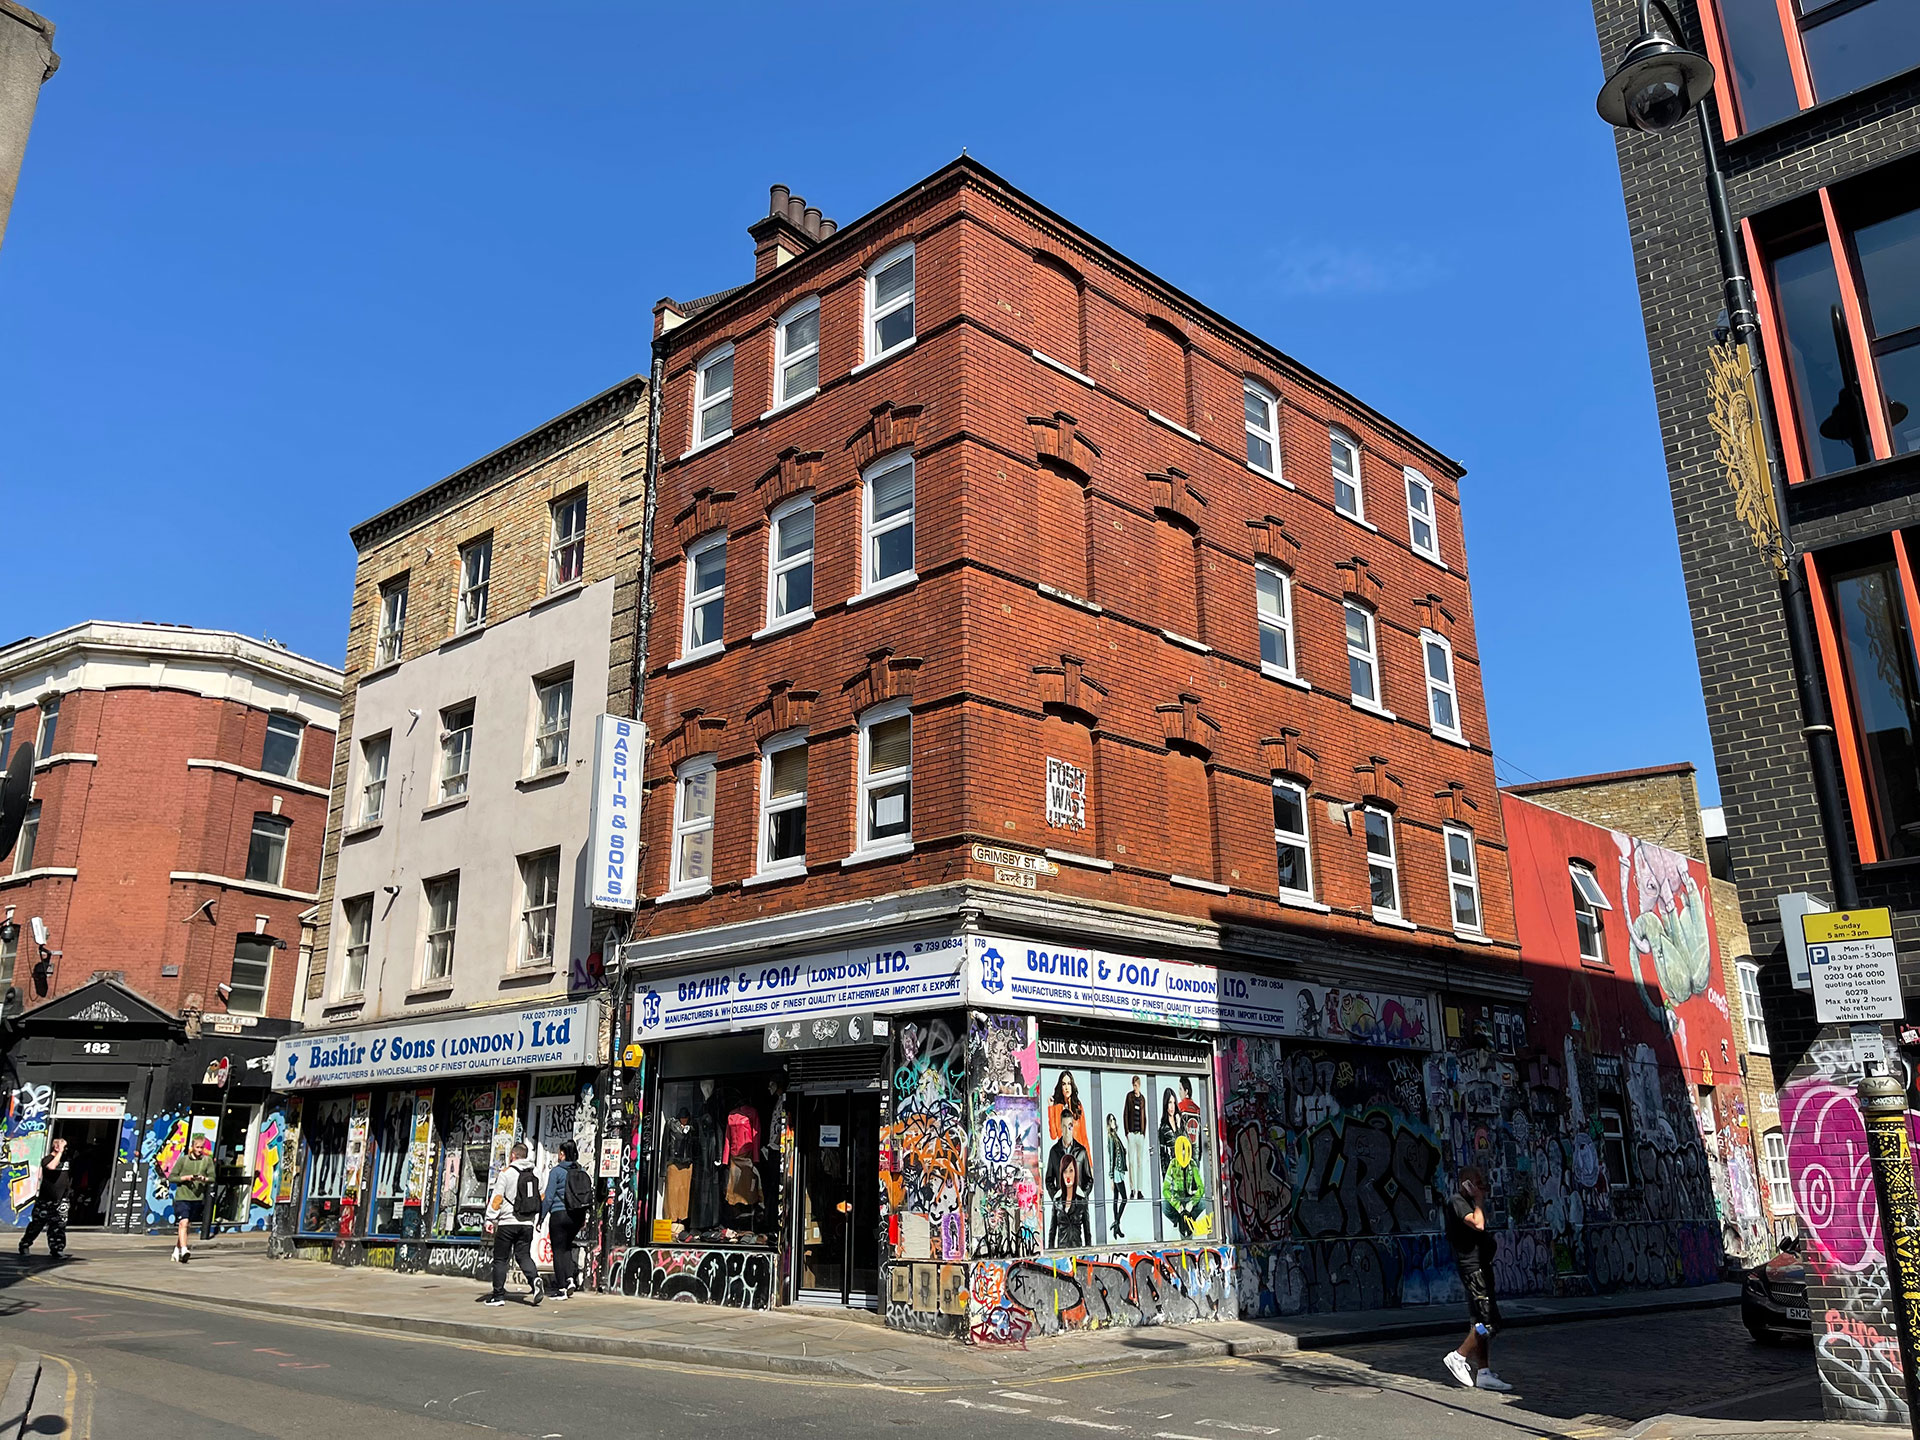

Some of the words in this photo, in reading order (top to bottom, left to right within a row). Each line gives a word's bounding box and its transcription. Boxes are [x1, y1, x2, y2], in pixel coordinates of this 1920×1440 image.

[613, 722, 630, 808] BASHIR
[612, 815, 627, 829] &
[608, 834, 625, 895] SONS
[977, 848, 1020, 866] GRIMSBY
[1024, 857, 1036, 869] ST.
[595, 895, 619, 903] LONDON
[925, 941, 939, 951] 739
[942, 938, 963, 949] 0834
[974, 938, 986, 948] 178
[1844, 945, 1859, 953] Mon
[1812, 948, 1826, 963] P
[1844, 963, 1853, 971] by
[1856, 962, 1878, 970] phone
[678, 975, 730, 1001] BASHIR
[738, 973, 751, 992] &
[757, 964, 800, 990] SONS
[807, 957, 871, 987] (LONDON)
[876, 950, 910, 974] LTD.
[1027, 949, 1088, 978] BASHIR
[1098, 959, 1111, 980] &
[1117, 963, 1159, 987] SONS
[1165, 972, 1219, 999] (LONDON)
[1223, 977, 1249, 999] LTD.
[1258, 979, 1267, 988] 739
[1269, 981, 1283, 990] 0834
[1825, 981, 1852, 989] quoting
[665, 1010, 713, 1024] MANUFACTURERS
[721, 1002, 767, 1016] WHOLESALERS
[770, 1000, 780, 1009] OF
[783, 998, 805, 1008] FINEST
[808, 993, 836, 1005] QUALITY
[838, 987, 890, 1001] LEATHERWEAR
[893, 984, 920, 995] IMPORT
[922, 983, 927, 992] &
[929, 979, 960, 991] EXPORT
[1011, 983, 1071, 999] MANUFACTURERS
[1081, 992, 1129, 1006] WHOLESALERS
[1131, 997, 1140, 1006] OF
[1142, 1000, 1164, 1010] FINEST
[1167, 1002, 1191, 1013] QUALITY
[1194, 1005, 1235, 1018] LEATHERWEAR
[1238, 1010, 1257, 1020] IMPORT
[1258, 1012, 1263, 1020] &
[1263, 1013, 1284, 1024] EXPORT
[1844, 997, 1860, 1005] stay
[534, 1011, 545, 1019] 020
[548, 1009, 562, 1018] 7739
[563, 1007, 577, 1016] 8115
[83, 1042, 111, 1054] 182
[310, 1042, 366, 1069] Bashir
[370, 1038, 386, 1063] &
[391, 1036, 435, 1061] Sons
[531, 1018, 570, 1047] Ltd
[1080, 1040, 1107, 1056] SONS
[1109, 1042, 1141, 1059] FINEST
[312, 1071, 368, 1082] MANUFACTURERS
[376, 1064, 427, 1076] WHOLESALERS
[429, 1063, 439, 1072] OF
[441, 1061, 467, 1071] FINEST
[469, 1058, 500, 1069] QUALITY
[502, 1052, 562, 1066] LEATHERWEAR
